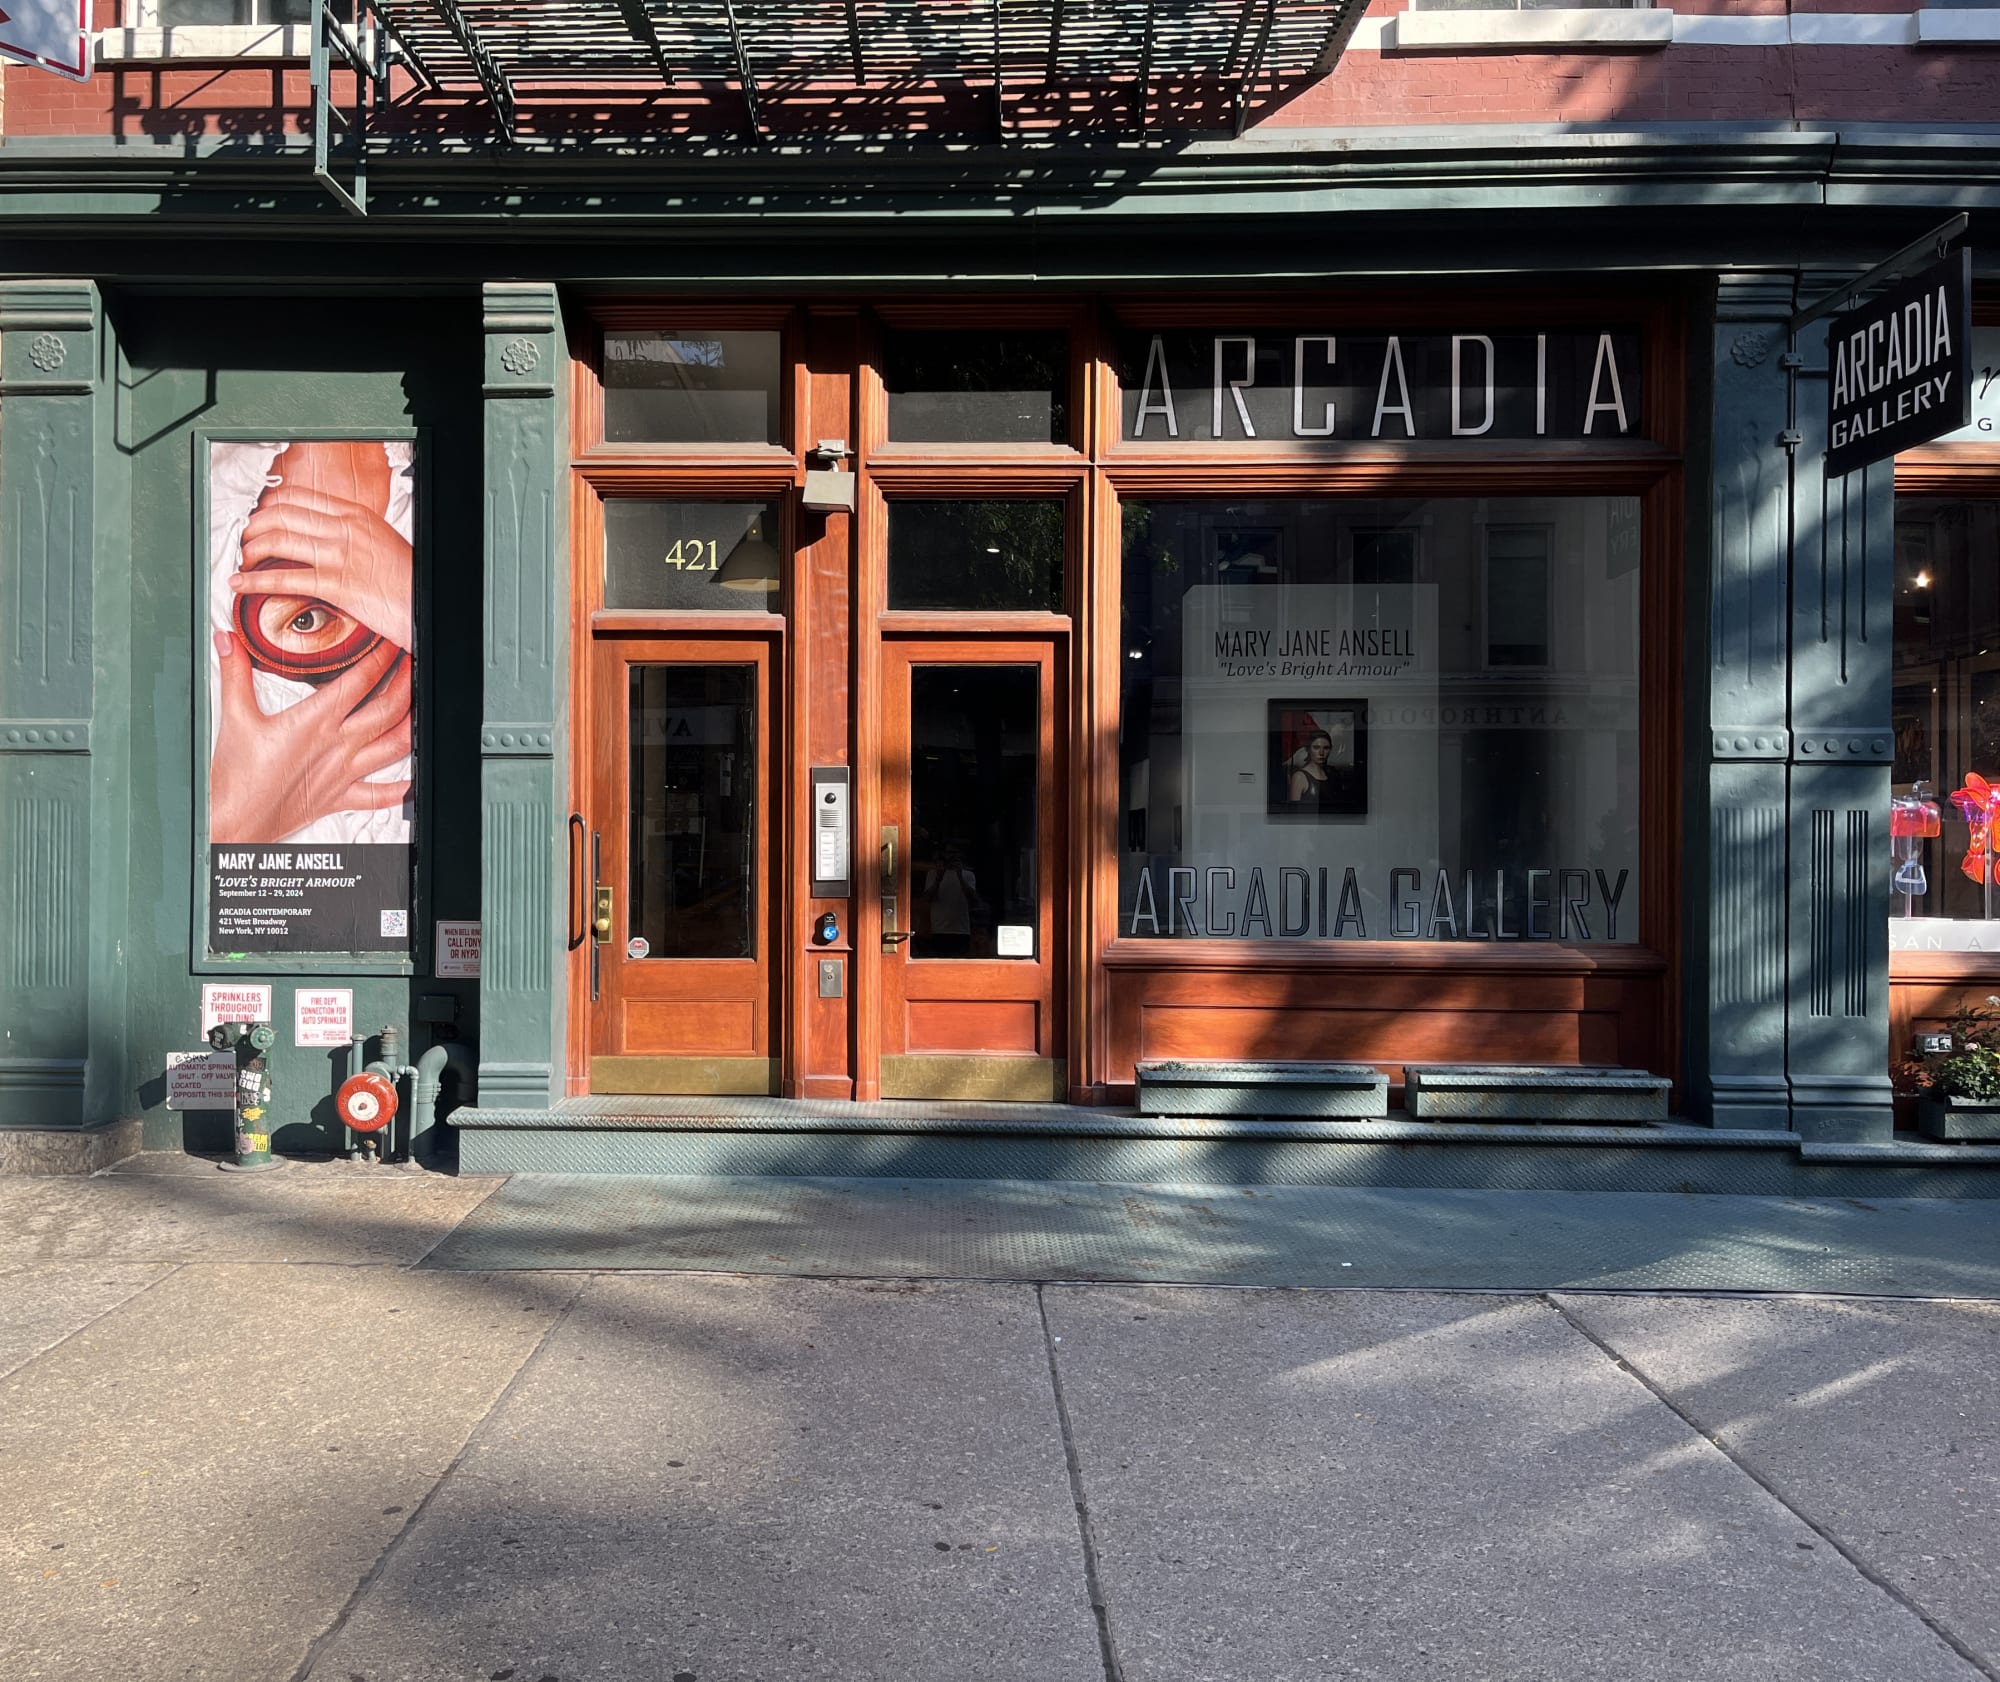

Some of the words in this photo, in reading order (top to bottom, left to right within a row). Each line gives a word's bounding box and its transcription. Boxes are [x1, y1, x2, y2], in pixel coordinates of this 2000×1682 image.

[1833, 284, 1952, 411] ARCADIA
[1132, 332, 1630, 438] ARCADIA
[1832, 371, 1952, 449] GALLERY
[664, 539, 719, 571] 421
[1215, 630, 1271, 658] MARY
[1279, 629, 1330, 657] JANE
[1339, 629, 1415, 657] ANSELL
[1281, 661, 1333, 680] Bright
[1337, 661, 1411, 677] Armour"
[218, 853, 255, 870] MARY
[259, 853, 292, 870] JANE
[295, 853, 344, 870] ANSELL
[260, 877, 304, 888] BRIGHT
[219, 889, 256, 898] September
[258, 889, 267, 897] 12
[286, 889, 304, 897] 2024
[1130, 866, 1367, 939] ARCADIA
[1389, 867, 1629, 940] GALLERY
[218, 908, 251, 916] ARCADIA
[252, 908, 312, 916] CONTEMPORARY
[252, 918, 287, 927] Broadway
[218, 927, 235, 935] New
[235, 927, 254, 936] York,
[255, 927, 265, 935] NY
[267, 927, 289, 935] 10012
[448, 938, 463, 947] CALL
[465, 938, 481, 947] FDNY
[451, 949, 459, 958] OR
[461, 949, 478, 958] NYPD
[211, 991, 262, 1002] SPRINKLERS
[310, 997, 323, 1006] FIRE
[210, 1002, 263, 1013] THROUGHOUT
[301, 1006, 335, 1015] CONNECTION
[336, 1006, 347, 1015] FOR
[217, 1013, 255, 1023] BUILDING
[302, 1016, 316, 1025] AUTO
[317, 1016, 347, 1025] SPRINKLER
[168, 1063, 207, 1071] AUTOMATIC
[177, 1072, 195, 1080] SHUT
